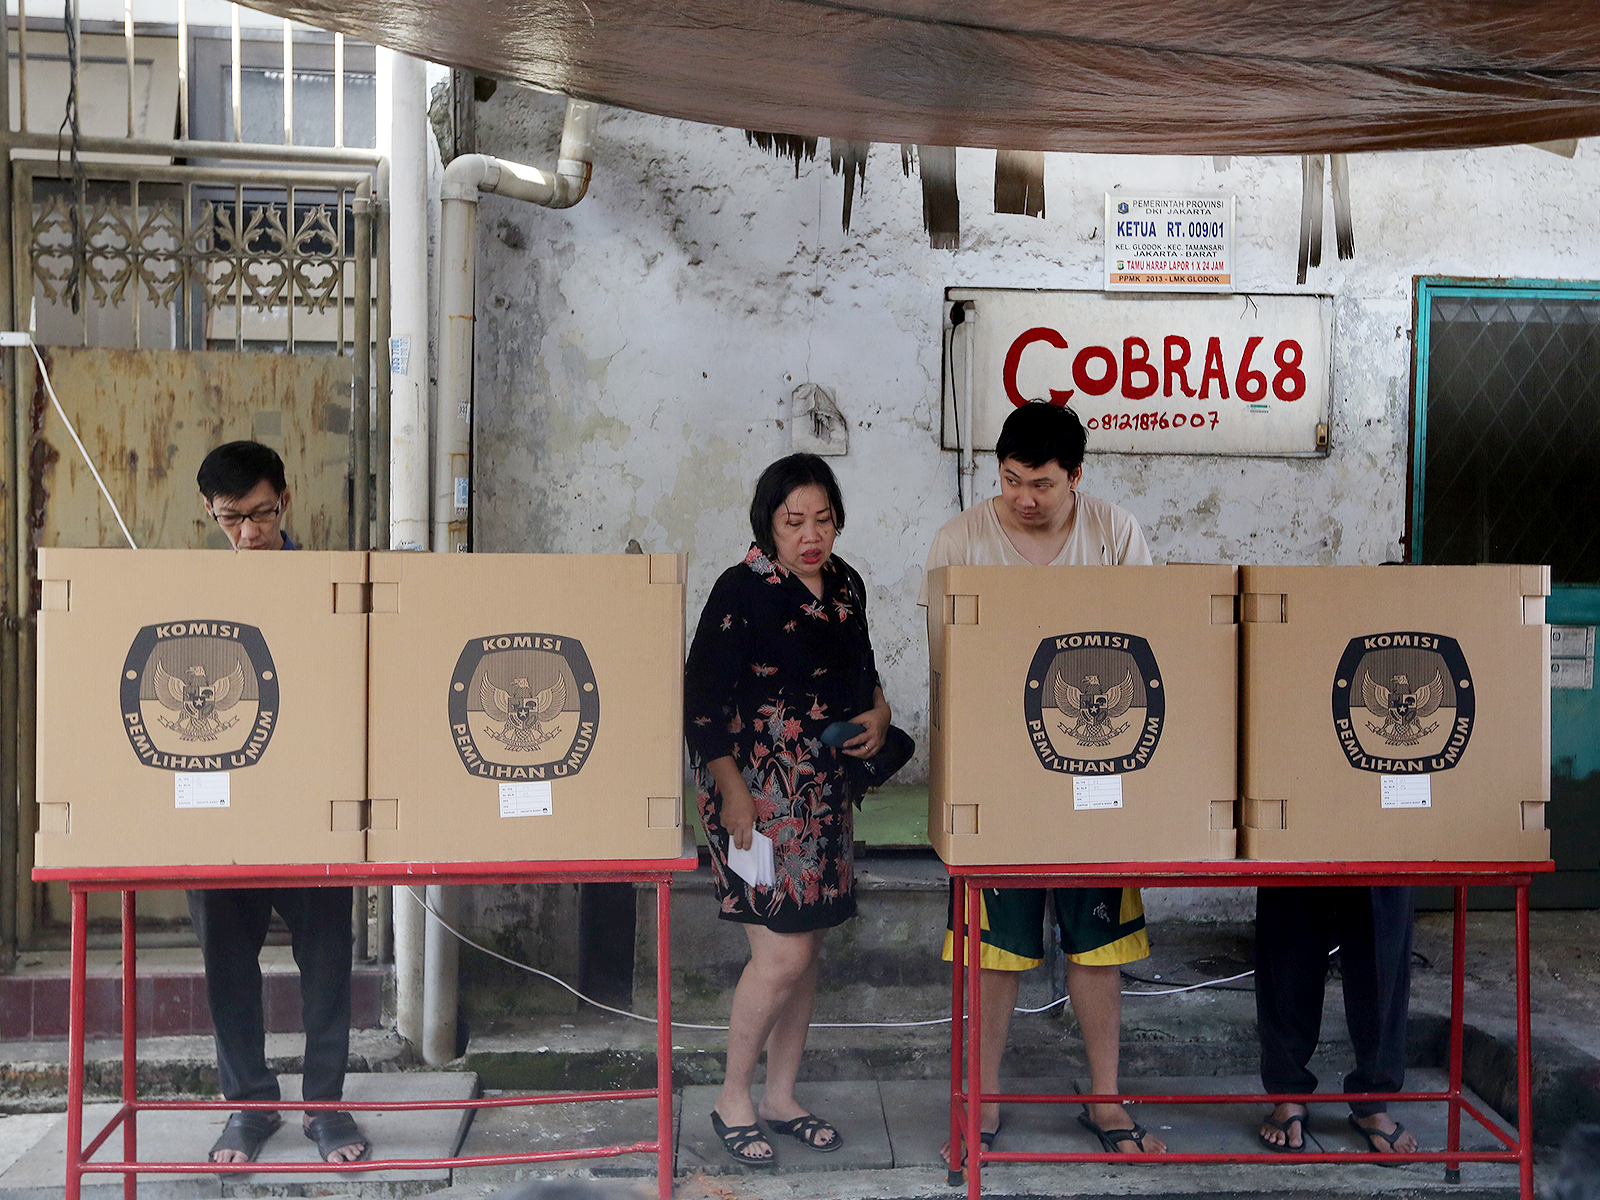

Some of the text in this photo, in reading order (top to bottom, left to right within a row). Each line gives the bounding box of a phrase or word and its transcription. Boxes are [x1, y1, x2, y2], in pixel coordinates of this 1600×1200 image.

[1132, 200, 1224, 208] PEMERINTAH PROVINSI
[1117, 221, 1224, 238] KETUA RT. 009/01
[1132, 243, 1162, 251] GLODOK
[1127, 260, 1224, 270] TAMU HARAP LAPOR 1 X 24 JAM
[1087, 411, 1220, 431] 08121876007
[156, 623, 240, 639] KOMISI
[482, 636, 562, 651] KOMISI
[1055, 635, 1130, 650] KOMISI
[1364, 635, 1439, 650] KOMISI
[125, 710, 273, 769] PEMILIHAN UMUM
[1029, 717, 1160, 773] PEMILIHAN UMUM
[1337, 717, 1470, 771] PEMILIHAN UMUM
[453, 721, 594, 778] PEMILIHAN UMUM
